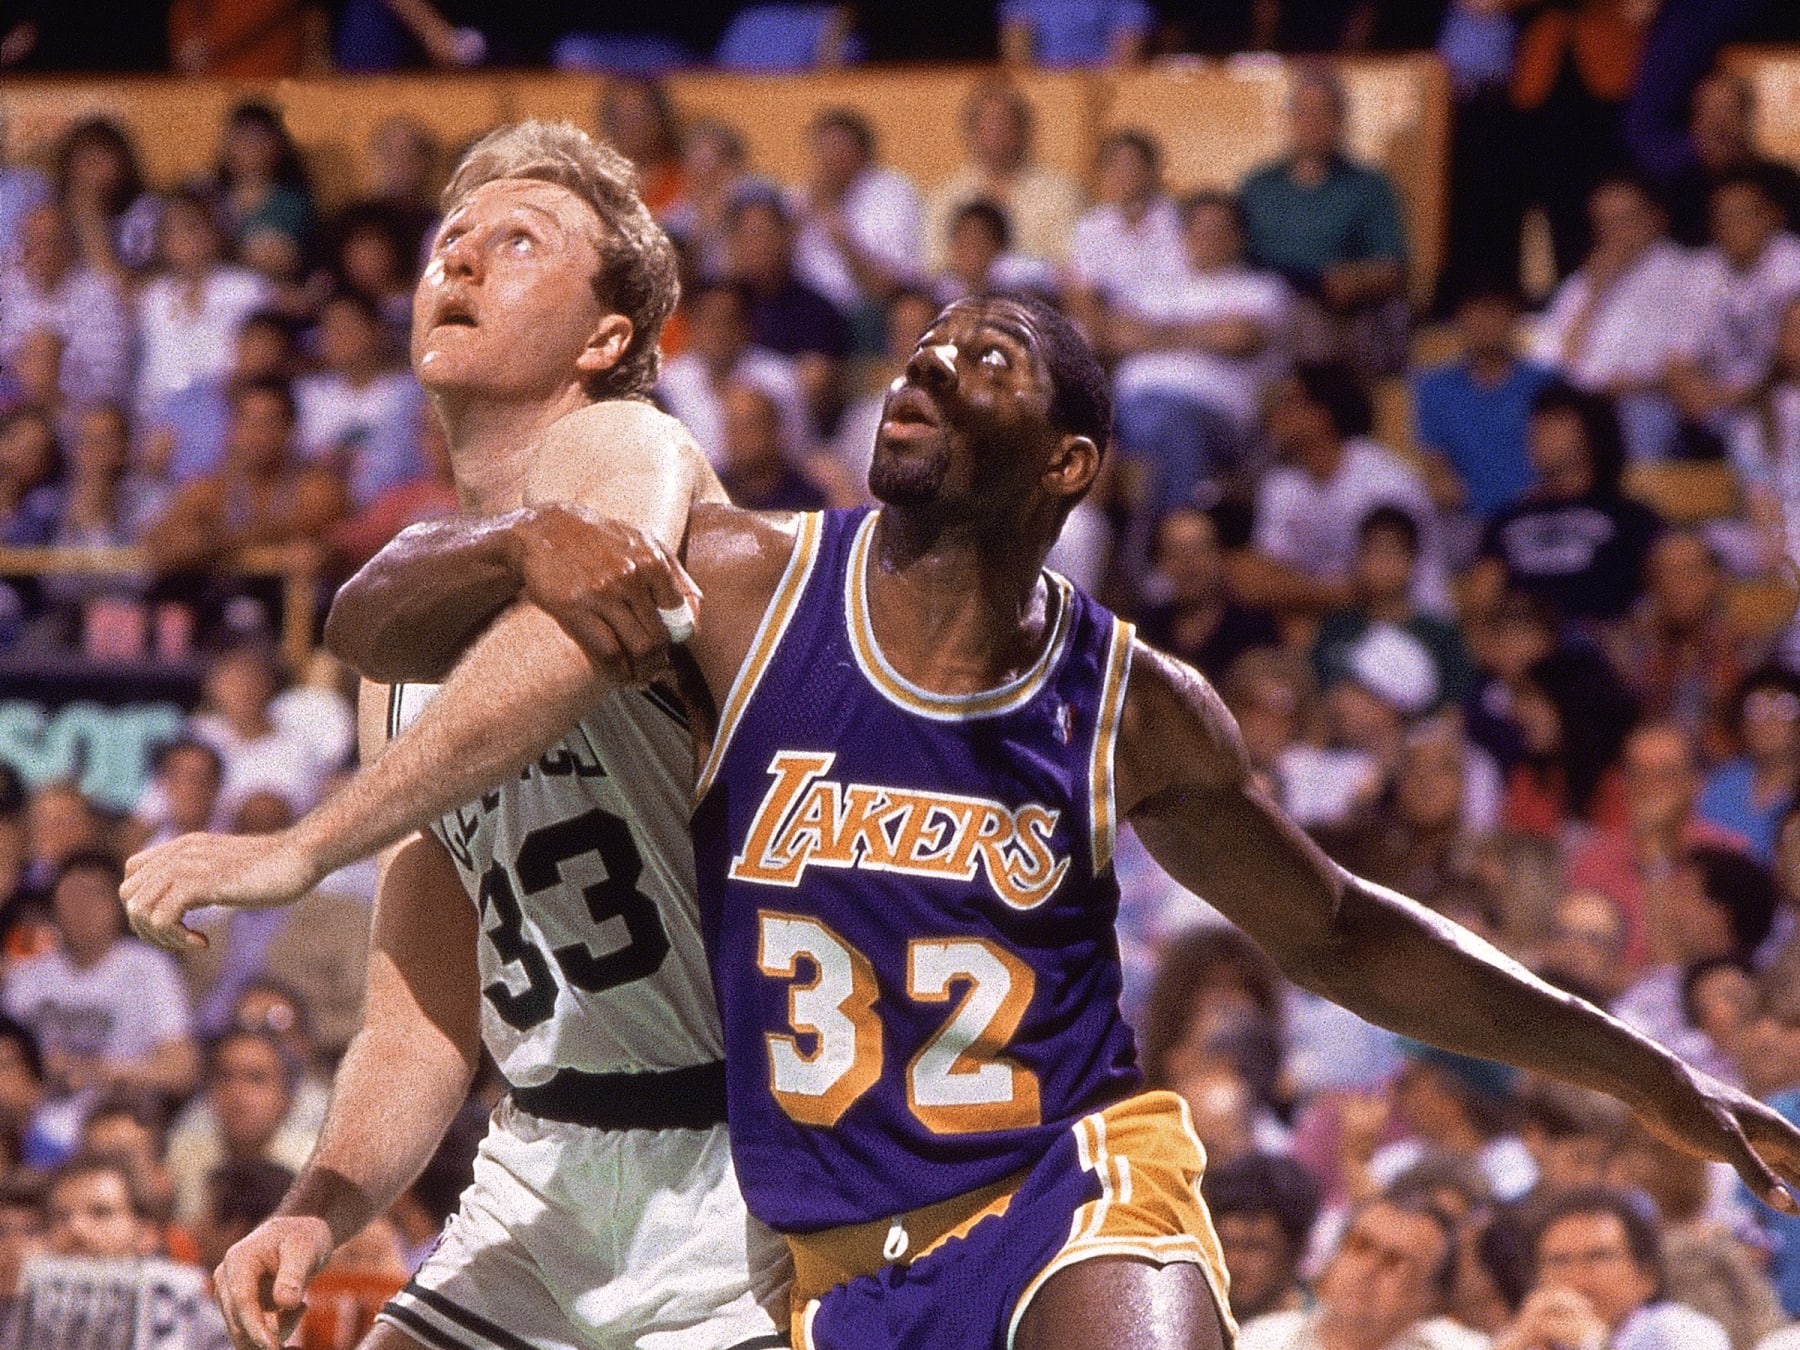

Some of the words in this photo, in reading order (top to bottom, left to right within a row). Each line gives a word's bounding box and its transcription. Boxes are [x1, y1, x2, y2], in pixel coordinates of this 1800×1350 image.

[479, 807, 671, 1032] 33
[728, 750, 1072, 911] LAKERS
[757, 907, 1042, 1135] 32
